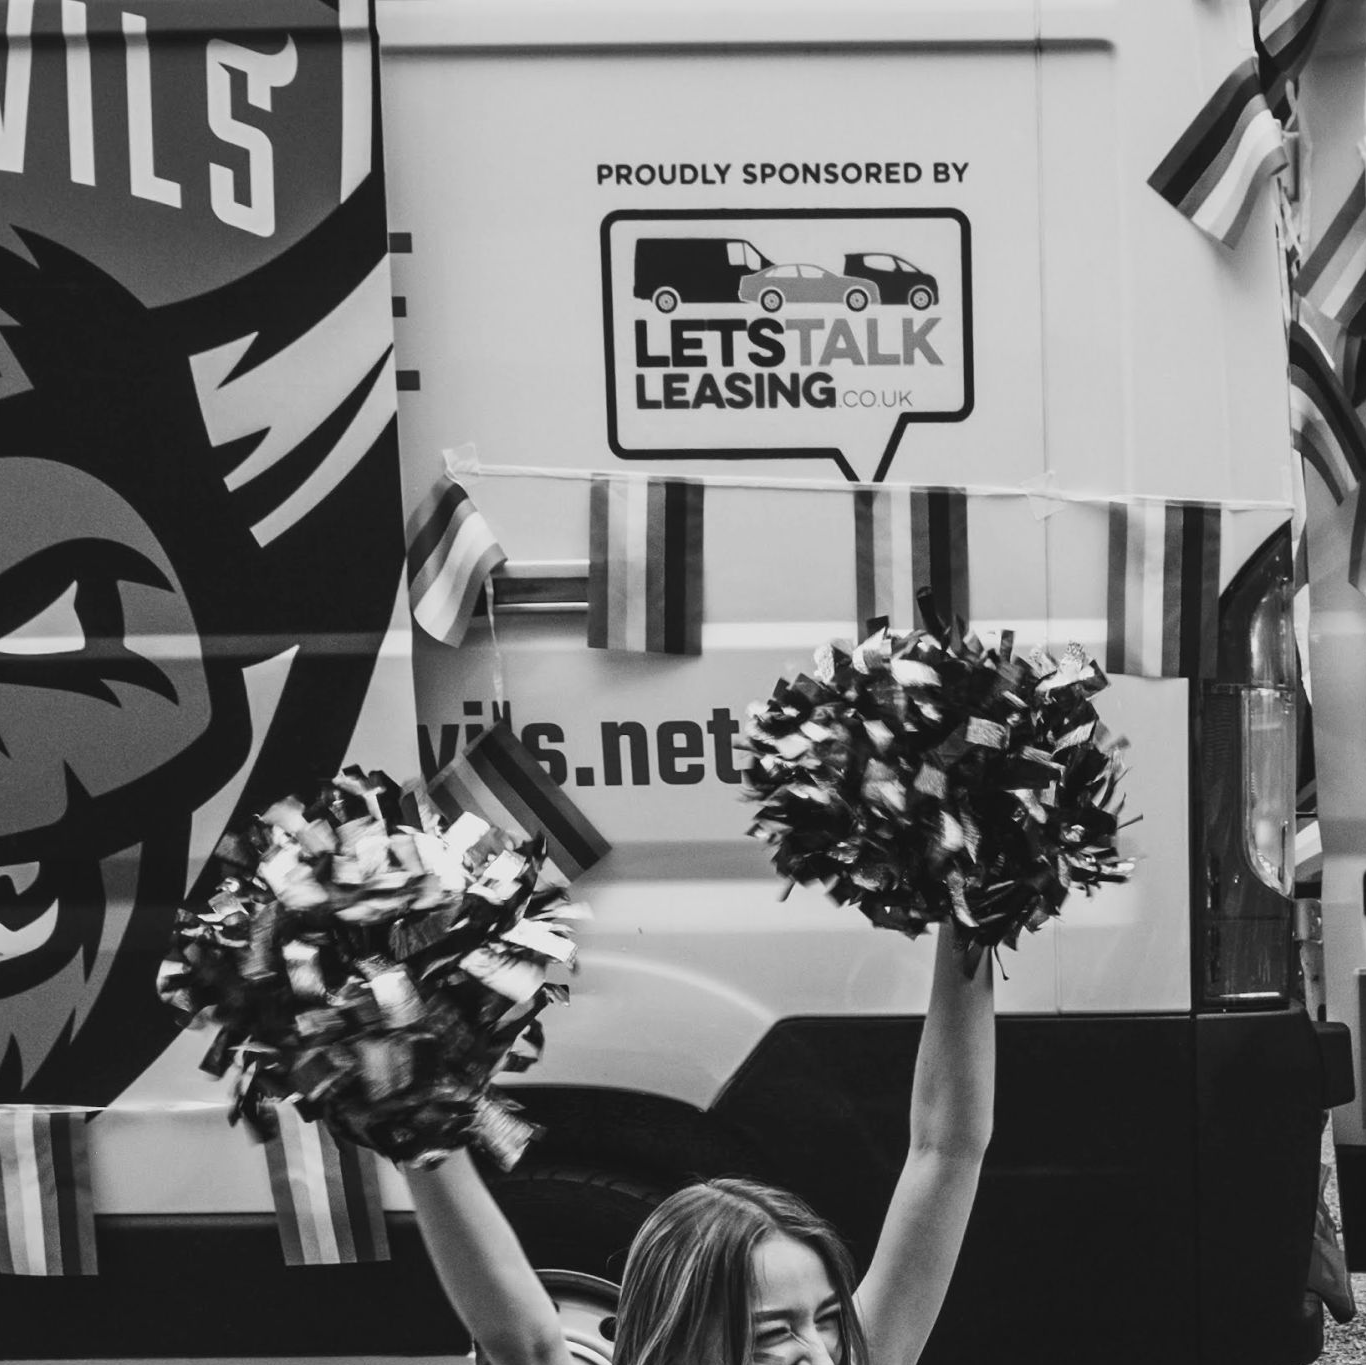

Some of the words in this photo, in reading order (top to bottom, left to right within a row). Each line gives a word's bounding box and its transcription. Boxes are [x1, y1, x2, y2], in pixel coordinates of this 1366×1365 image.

[597, 163, 731, 185] PROUDLY
[742, 162, 922, 184] SPONSORED
[933, 162, 969, 183] BY
